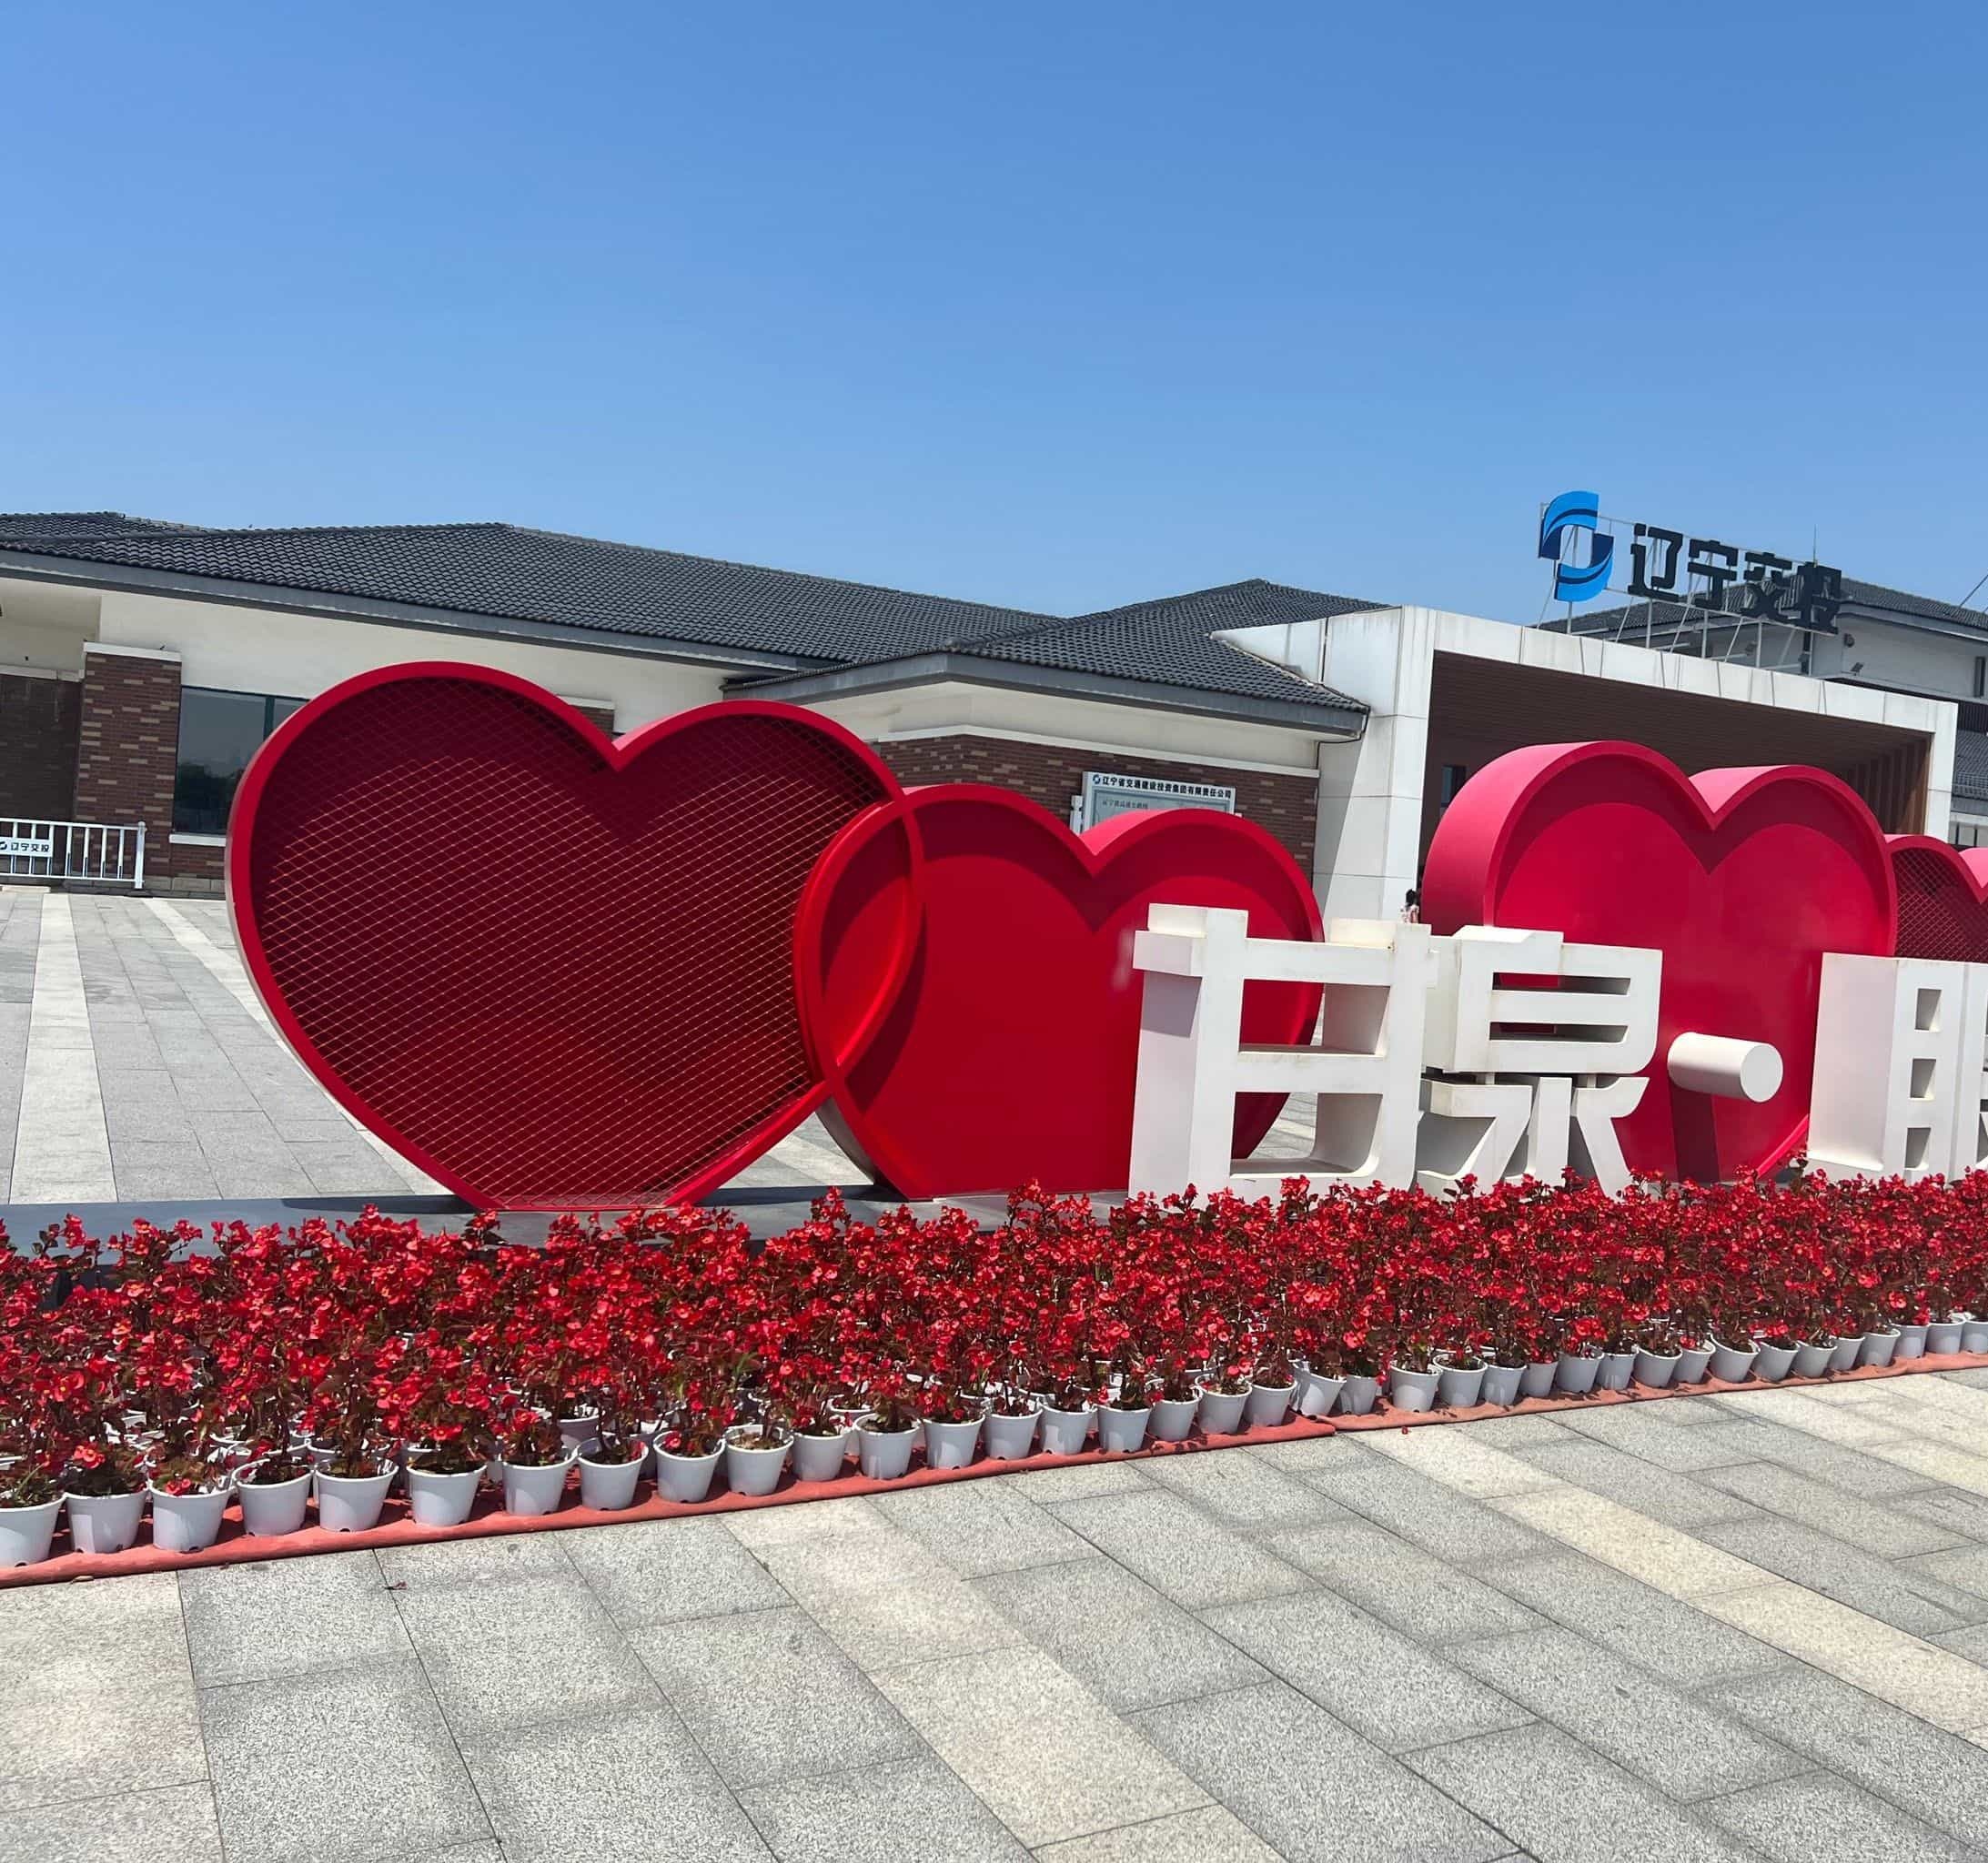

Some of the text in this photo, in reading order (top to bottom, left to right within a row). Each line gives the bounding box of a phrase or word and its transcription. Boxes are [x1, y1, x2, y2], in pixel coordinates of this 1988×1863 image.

[1628, 523, 1842, 634] 辽宁交投
[10, 841, 50, 853] 辽宁交投
